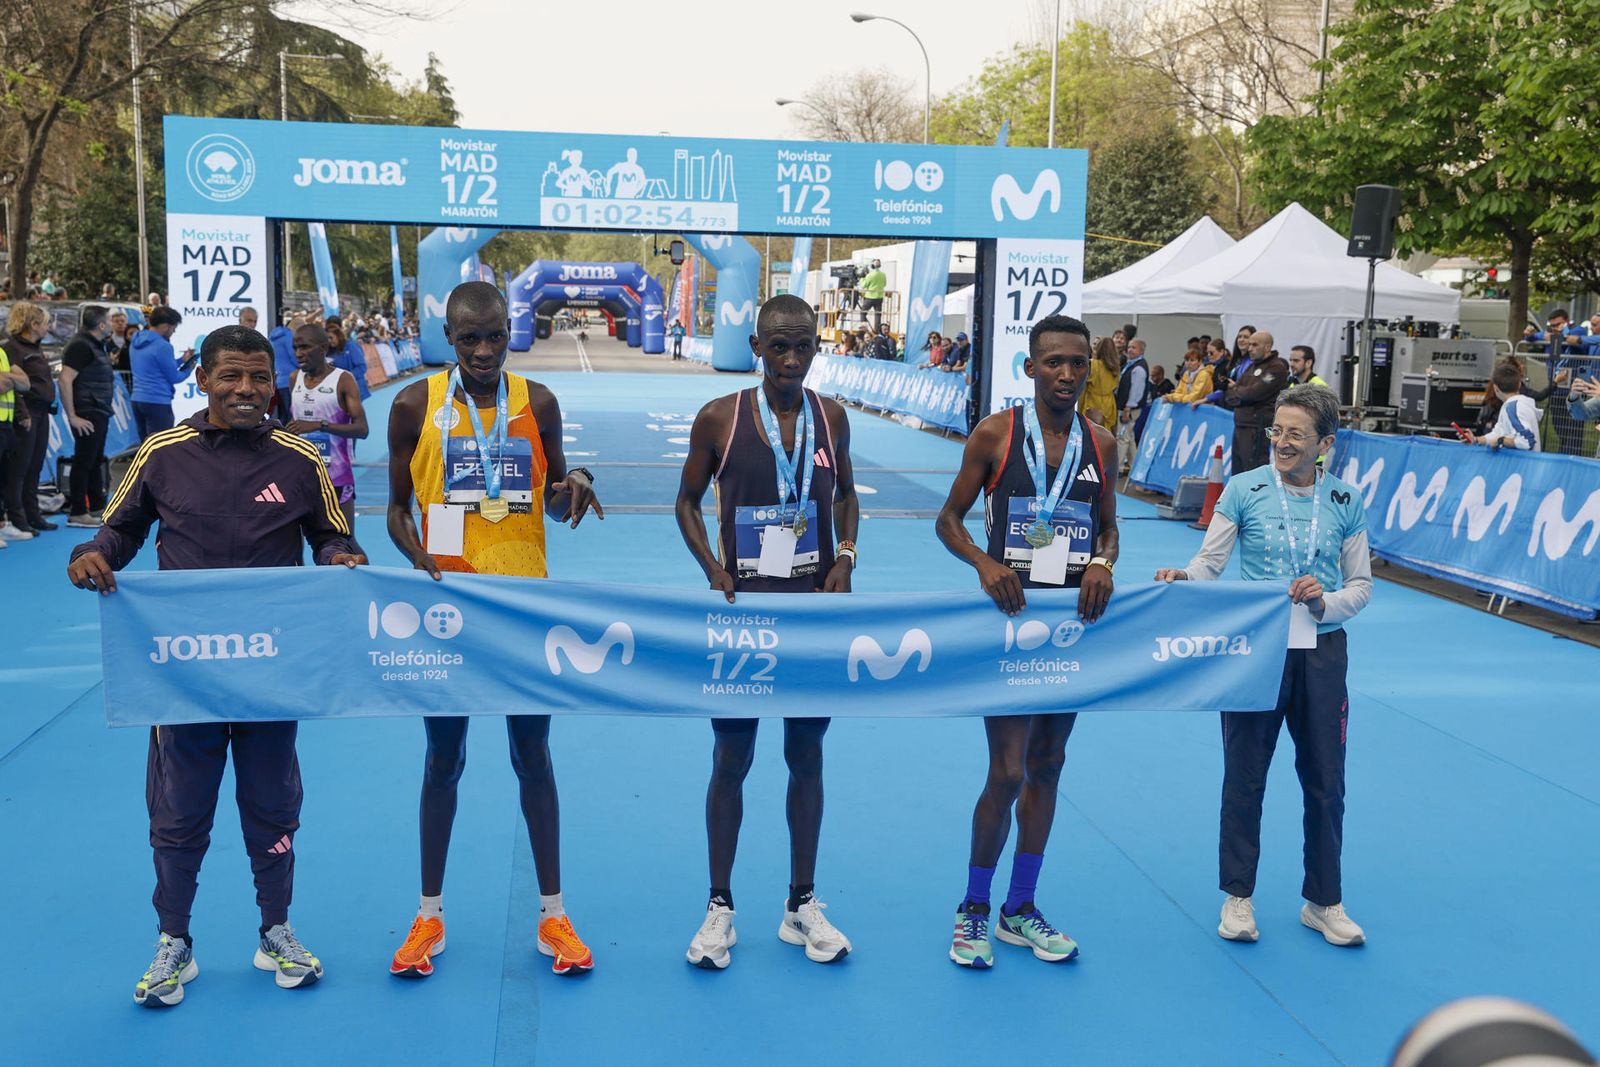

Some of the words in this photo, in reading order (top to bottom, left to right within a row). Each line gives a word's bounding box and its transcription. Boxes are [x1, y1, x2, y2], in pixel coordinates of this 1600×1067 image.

[441, 138, 497, 151] Movistar
[441, 152, 498, 173] MAD
[778, 150, 832, 162] Movistar
[777, 163, 832, 183] MAD
[441, 174, 498, 205] 1/2
[777, 184, 832, 214] 1/2
[873, 198, 943, 213] Telefónica
[441, 205, 498, 218] MARATÓN
[776, 214, 831, 227] MARATÓN
[882, 215, 910, 225] desde
[911, 215, 932, 225] 1924
[181, 228, 252, 242] Movistar
[182, 244, 252, 266] MAD
[1008, 252, 1070, 264] Movistar
[1007, 267, 1069, 287] MAD
[183, 269, 253, 303] 1/2
[184, 306, 242, 318] MARATÓ
[1007, 290, 1068, 321] 1/2
[1010, 522, 1089, 540] ESOND
[706, 612, 779, 626] Movistar
[707, 628, 779, 650] MAD
[1152, 634, 1252, 662] Joma
[368, 650, 464, 667] Telefónica
[706, 652, 778, 681] 1/2
[998, 657, 1080, 673] Telefónica
[382, 671, 420, 682] desde
[422, 670, 449, 681] 1924
[1007, 675, 1041, 686] desde
[1043, 675, 1068, 685] 1924
[702, 681, 774, 695] MARATÓN
